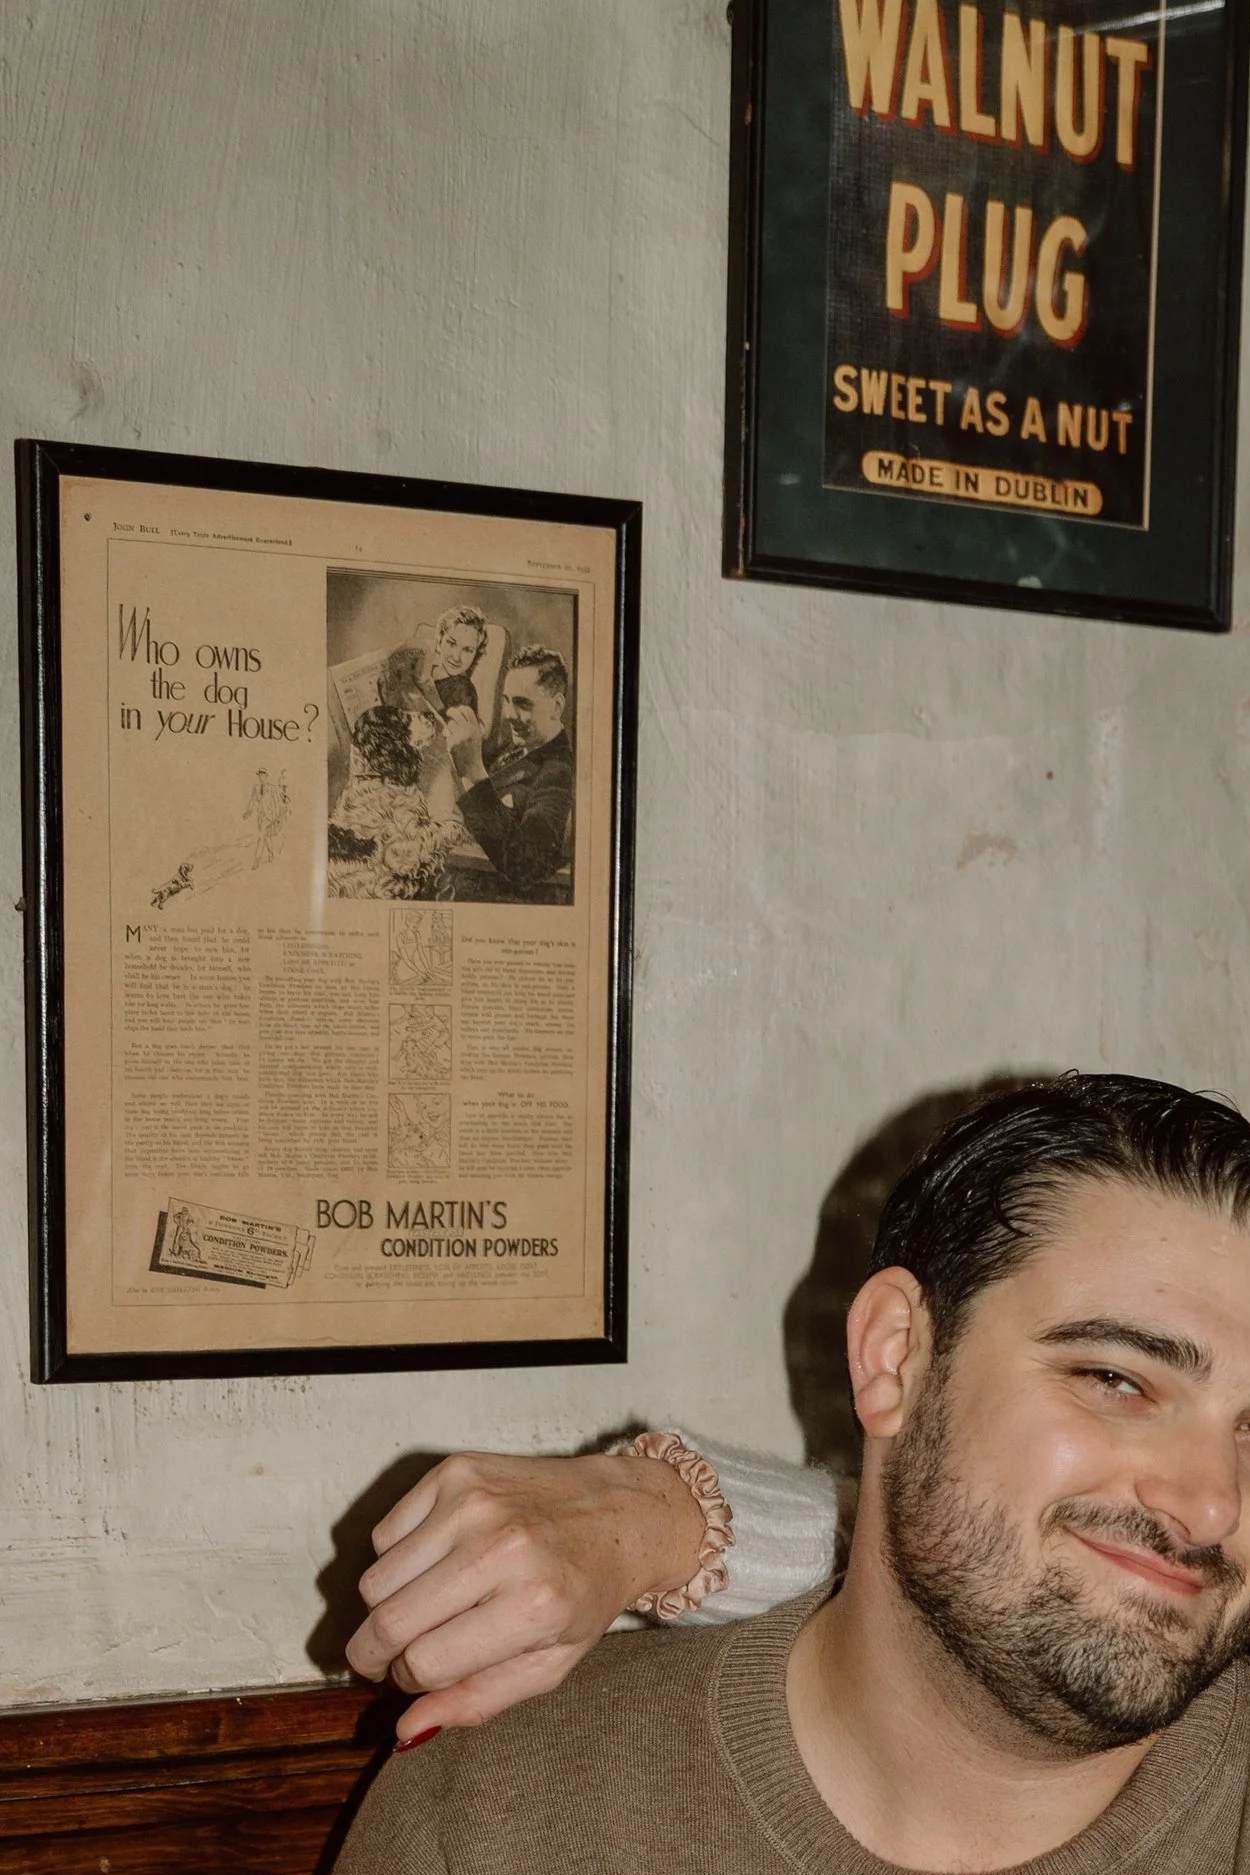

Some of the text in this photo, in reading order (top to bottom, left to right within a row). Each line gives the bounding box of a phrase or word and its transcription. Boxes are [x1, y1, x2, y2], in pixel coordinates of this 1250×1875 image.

[838, 0, 1151, 170] WALNUT
[884, 182, 1087, 346] PLUG
[833, 364, 1133, 455] SWEET AS A NUT
[877, 457, 1089, 509] MADE IN DUBLIN
[139, 524, 161, 535] BULL
[119, 603, 262, 673] Who owns
[150, 667, 248, 710] the dog
[120, 702, 319, 743] in your House?
[219, 1215, 237, 1223] BOB
[316, 1199, 508, 1230] BOB MARTIN'S
[202, 1234, 246, 1248] CONDITION
[380, 1237, 559, 1258] CONDITION POWDERS
